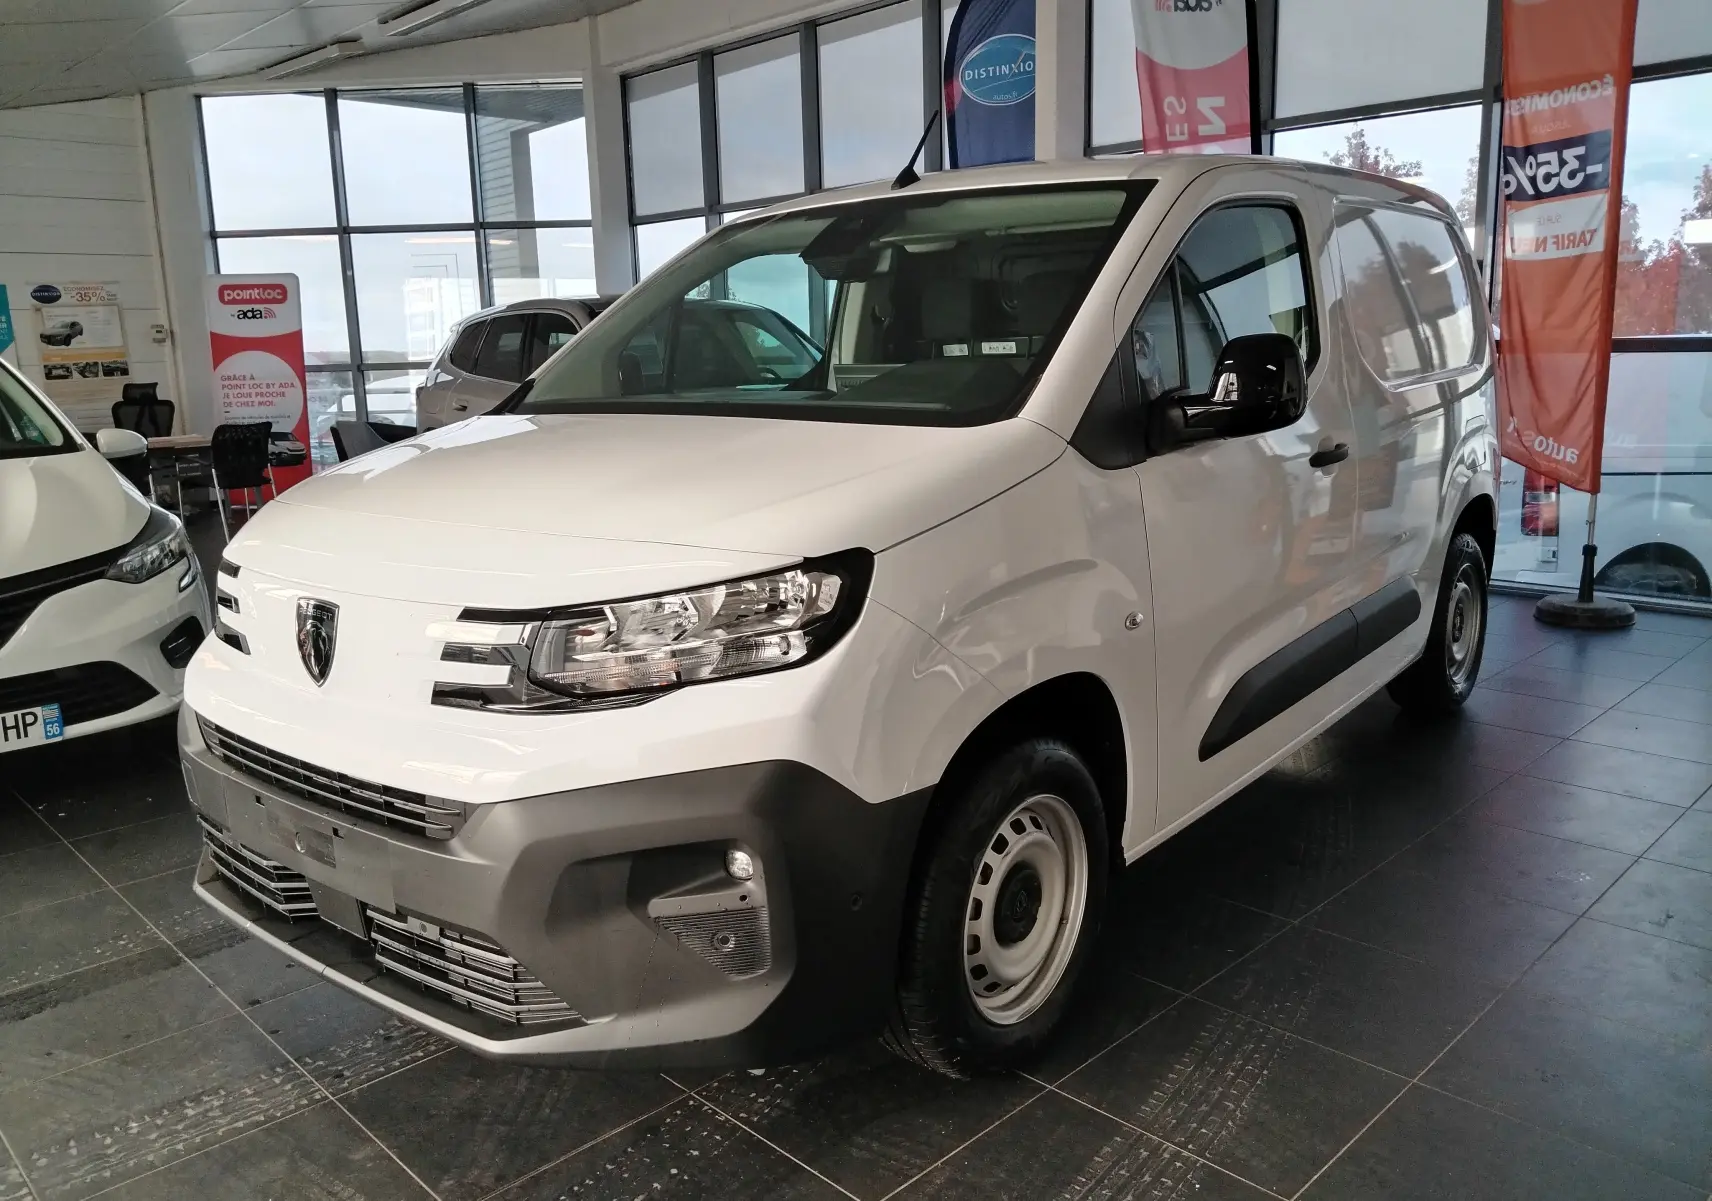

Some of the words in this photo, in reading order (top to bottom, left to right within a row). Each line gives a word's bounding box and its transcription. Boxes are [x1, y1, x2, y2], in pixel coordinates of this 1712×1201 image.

[965, 60, 1034, 80] DISTINXIO
[70, 291, 106, 303] -35%
[237, 307, 263, 320] ada
[221, 374, 247, 382] GRÂCE
[249, 373, 256, 381] À
[223, 392, 231, 400] JE
[232, 391, 253, 399] LOUE
[299, 607, 333, 620] PEUGEOT
[46, 723, 60, 736] 56
